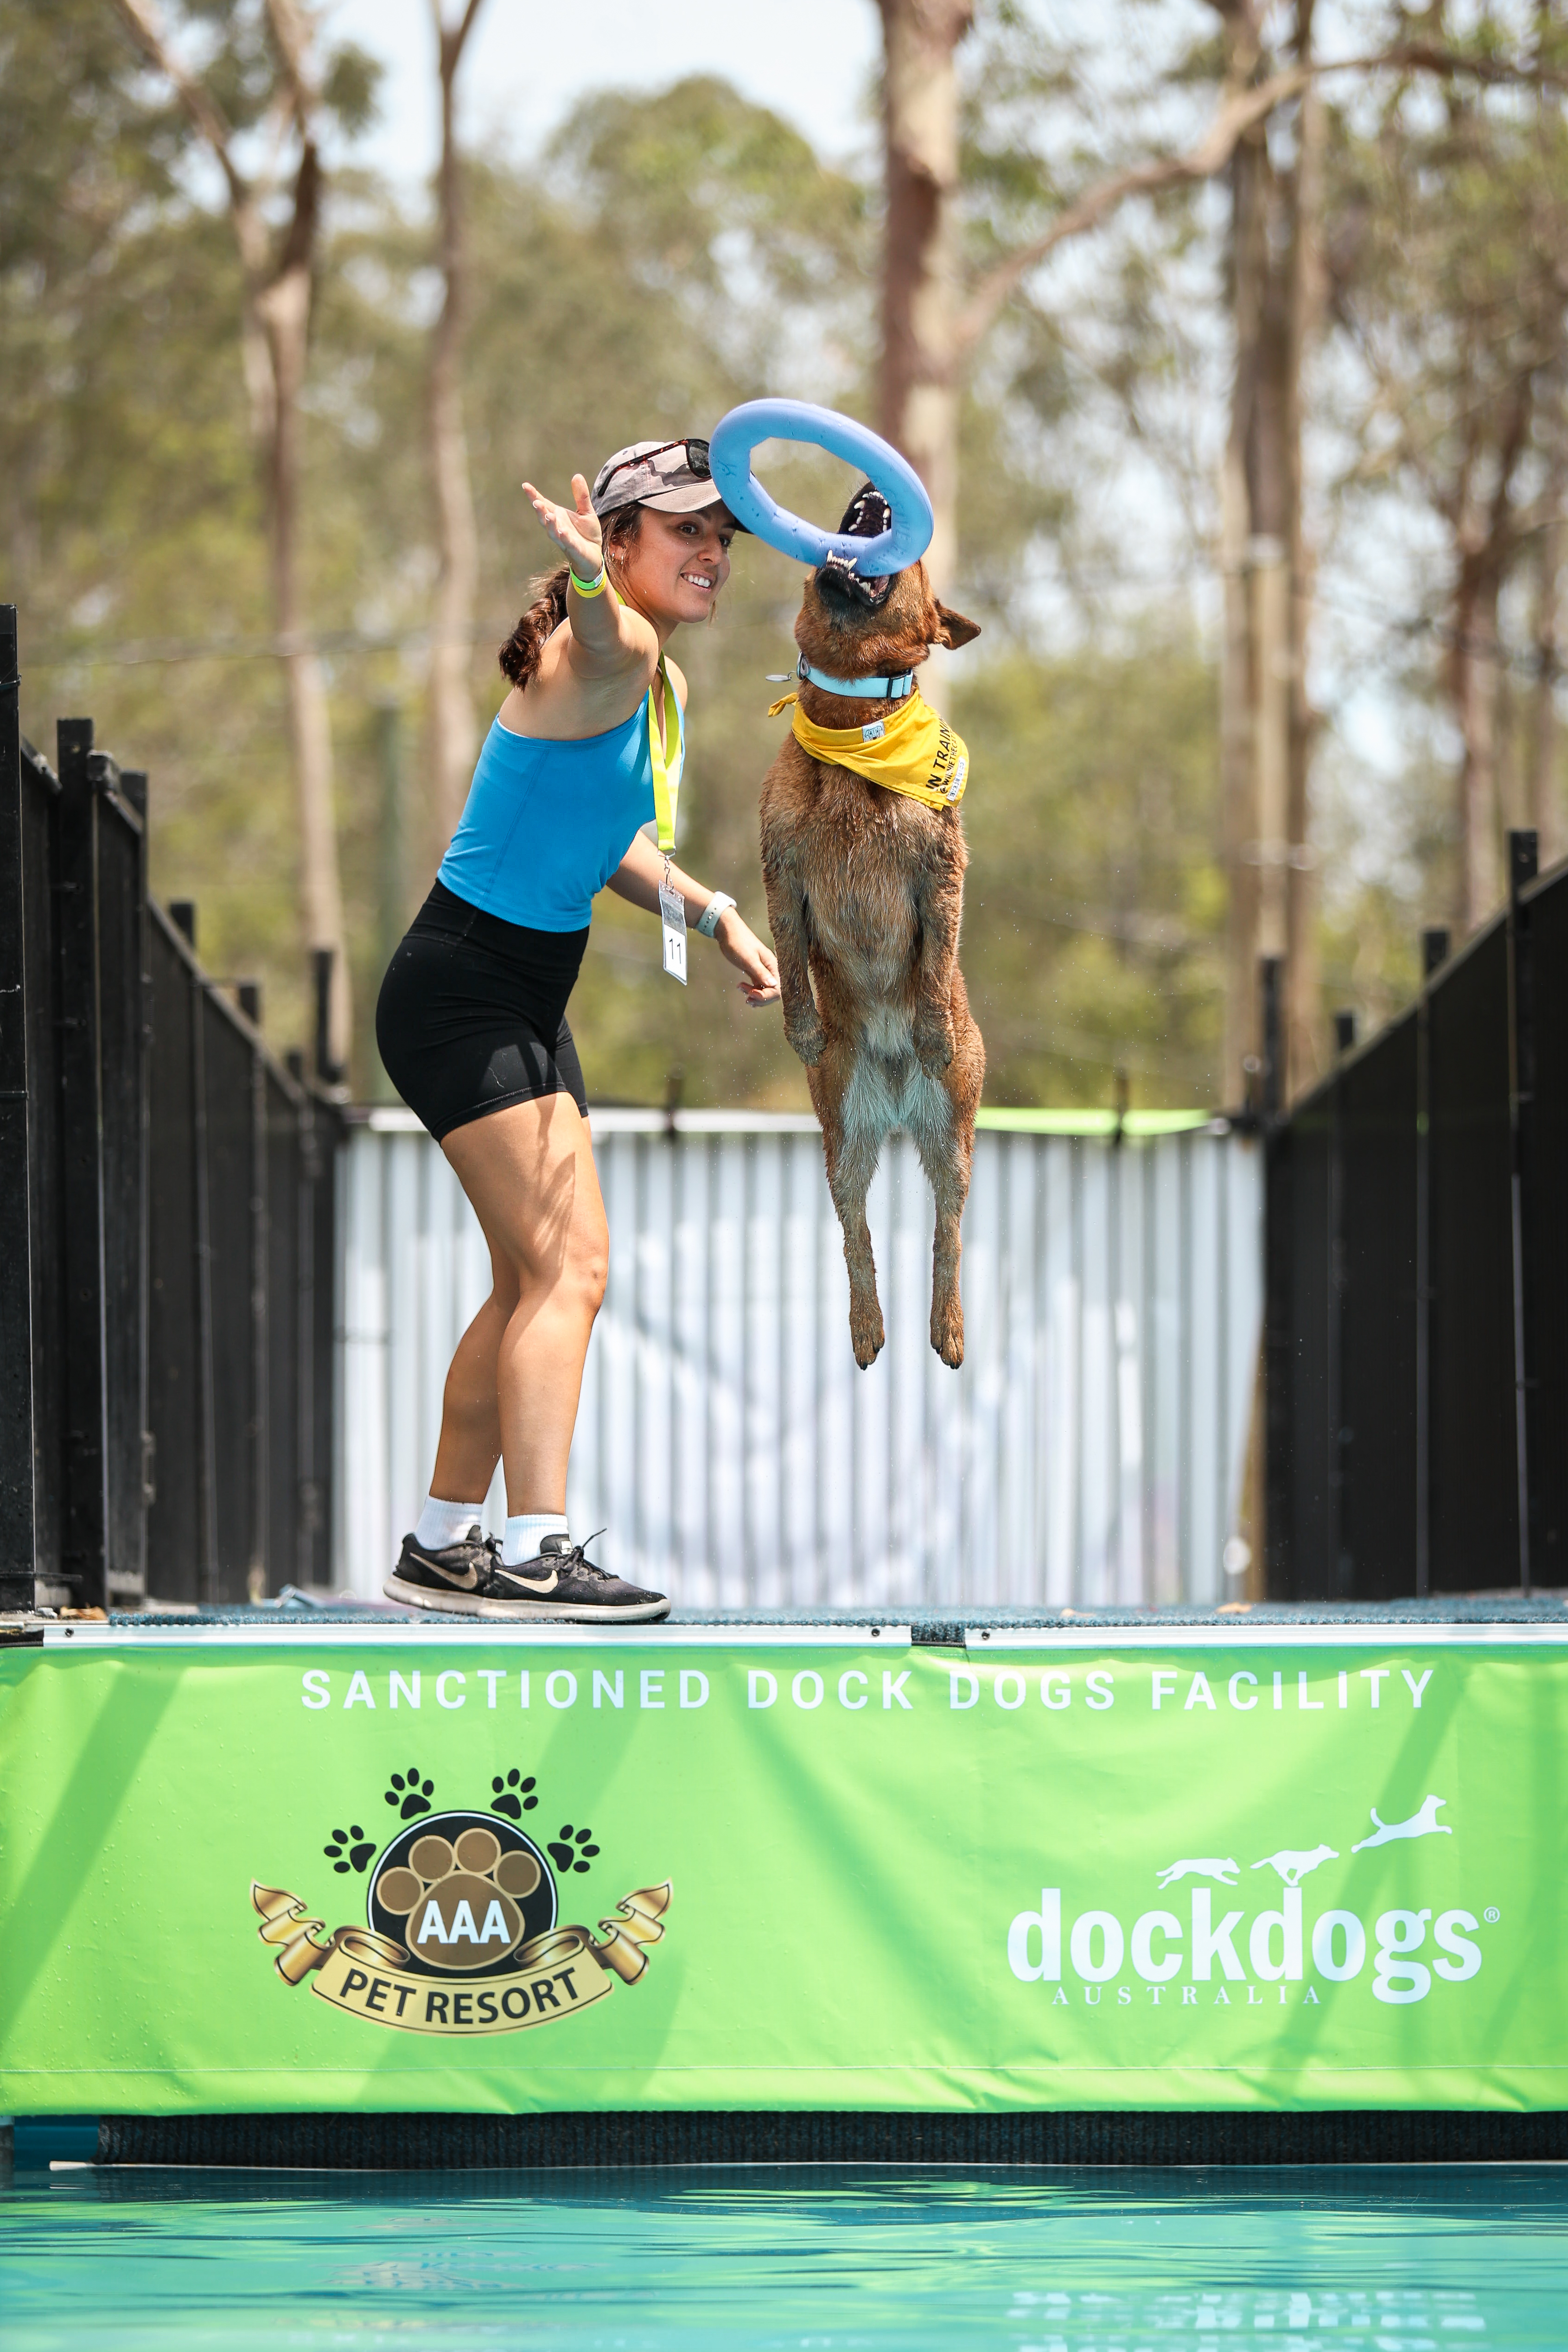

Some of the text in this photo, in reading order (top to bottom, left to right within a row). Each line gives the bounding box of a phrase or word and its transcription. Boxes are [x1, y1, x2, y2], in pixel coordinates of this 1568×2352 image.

[925, 774, 942, 789] IN
[669, 938, 682, 964] 11
[301, 1670, 1434, 1710] SANCTIONED DOCK DOGS FACILITY
[416, 1900, 511, 1944] AAA
[339, 1968, 578, 2025] PET RESORT
[1052, 1986, 1321, 2005] AUSTRALIA
